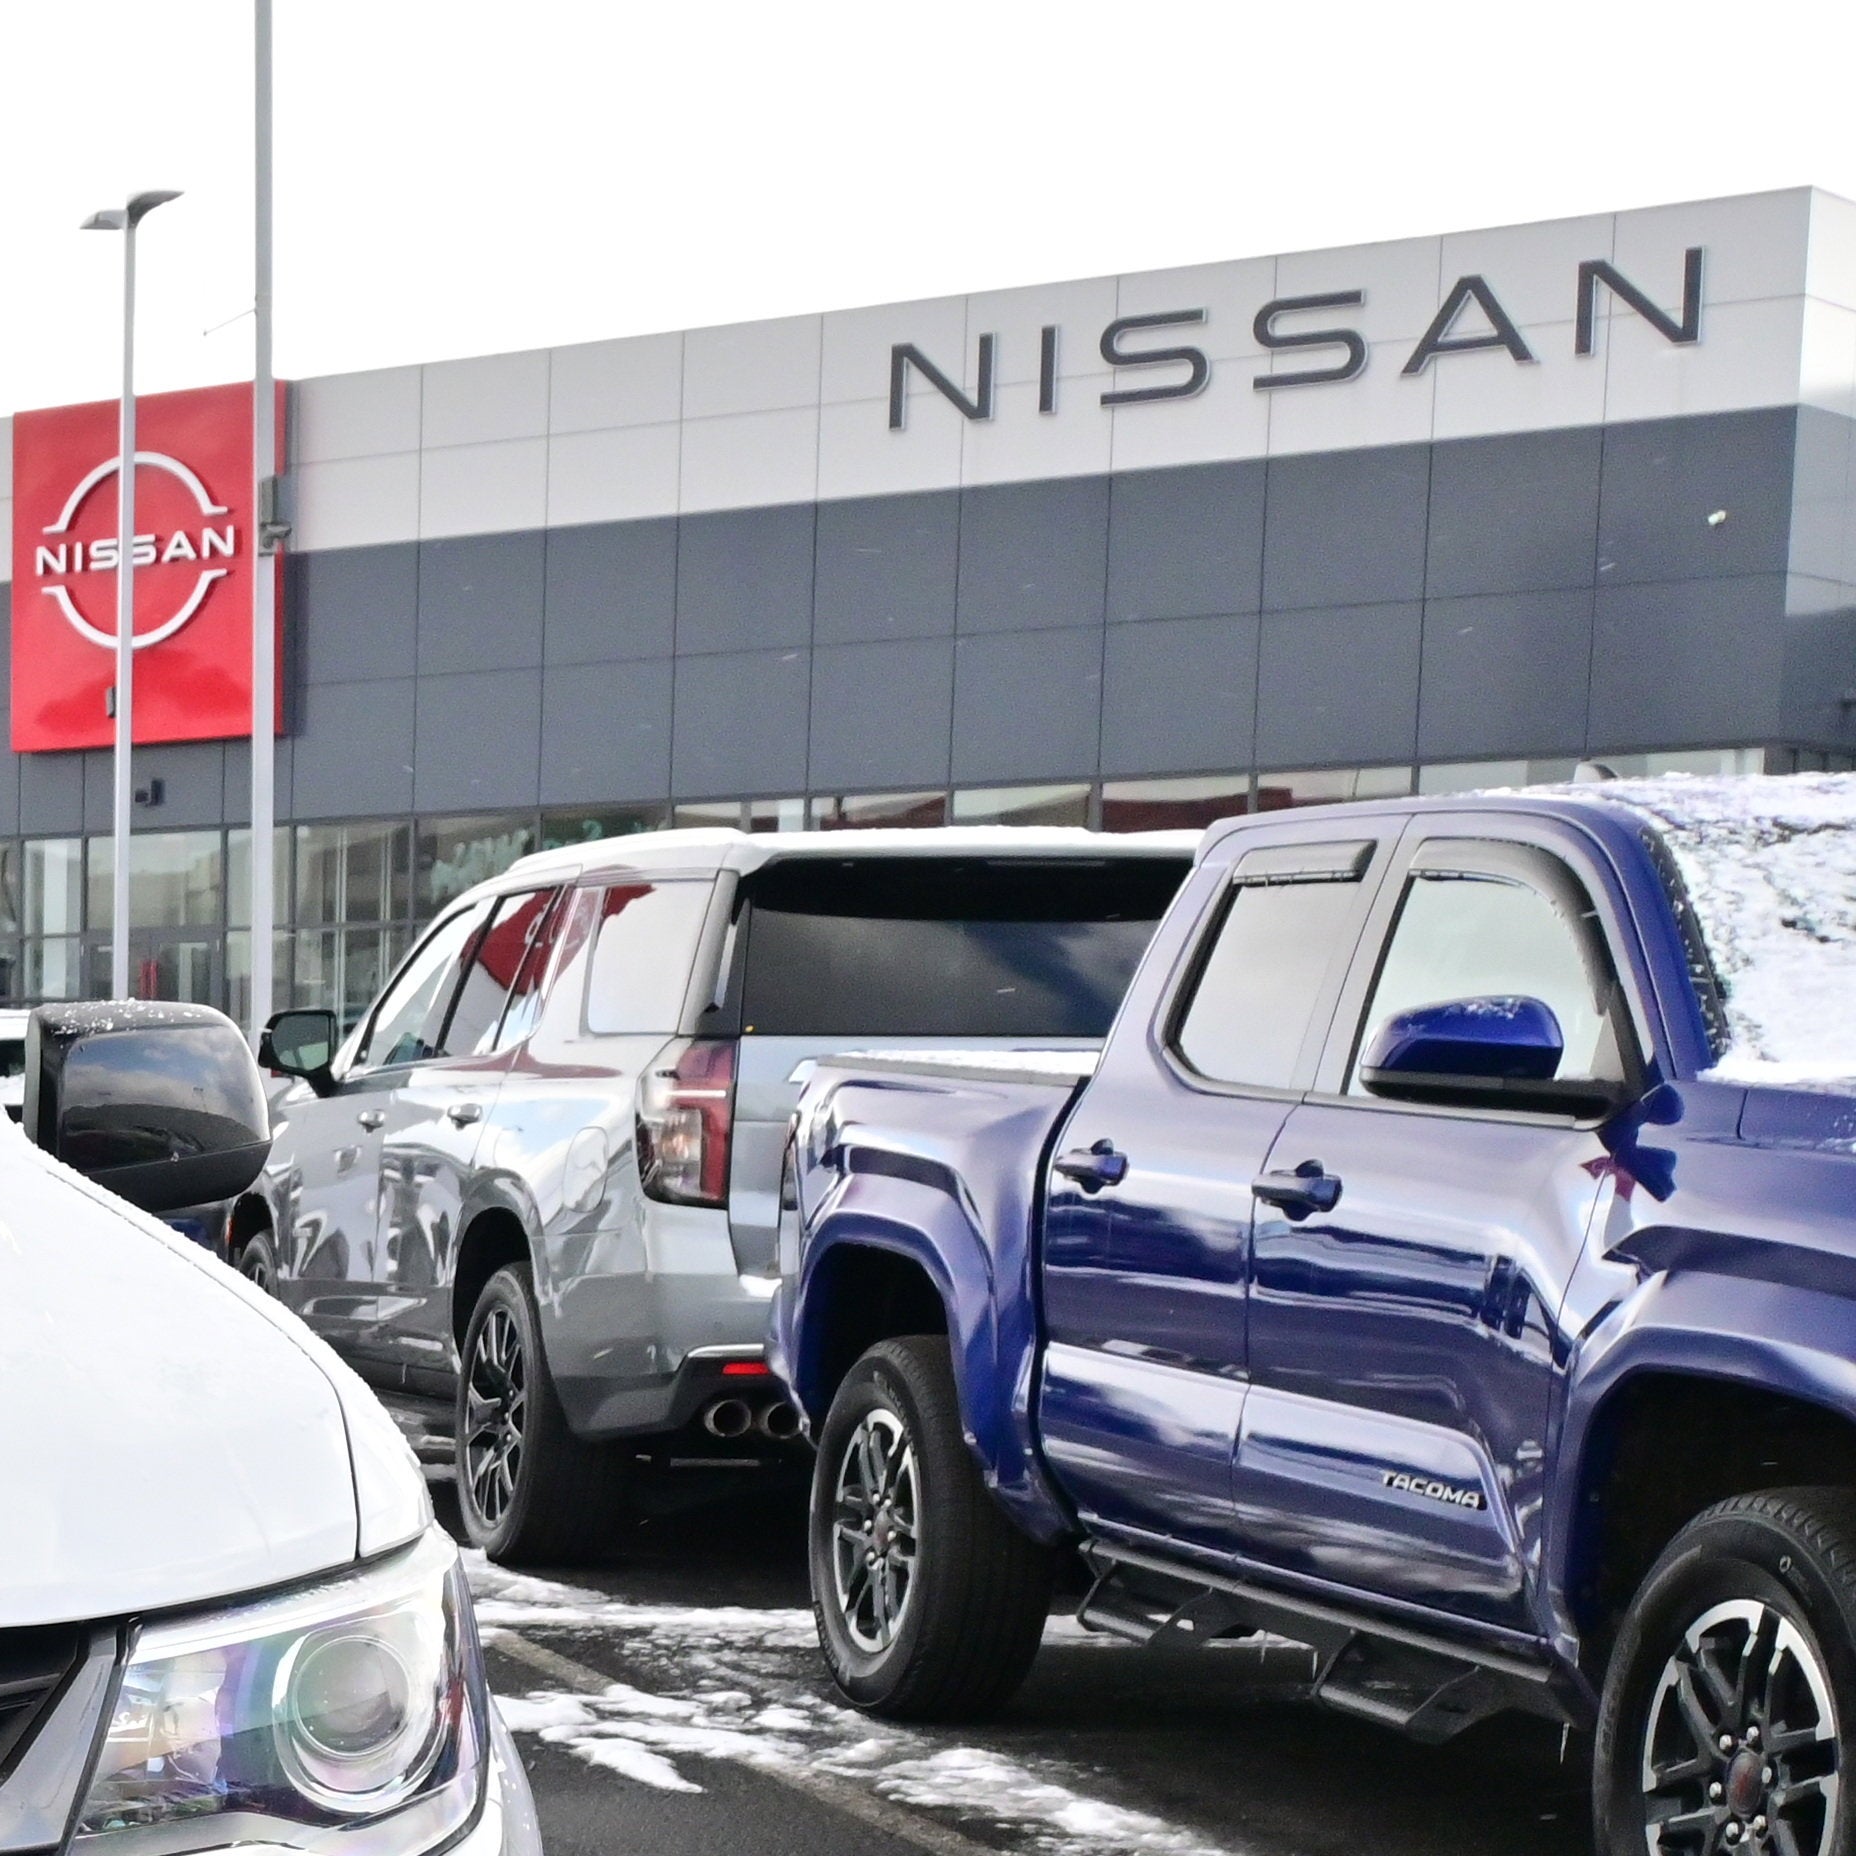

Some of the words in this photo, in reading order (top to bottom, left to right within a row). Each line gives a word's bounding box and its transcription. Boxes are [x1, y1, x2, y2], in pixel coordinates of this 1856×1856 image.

[889, 246, 1705, 431] NISSAN
[35, 525, 234, 576] NISSAN
[1382, 1470, 1480, 1508] TACOMA
